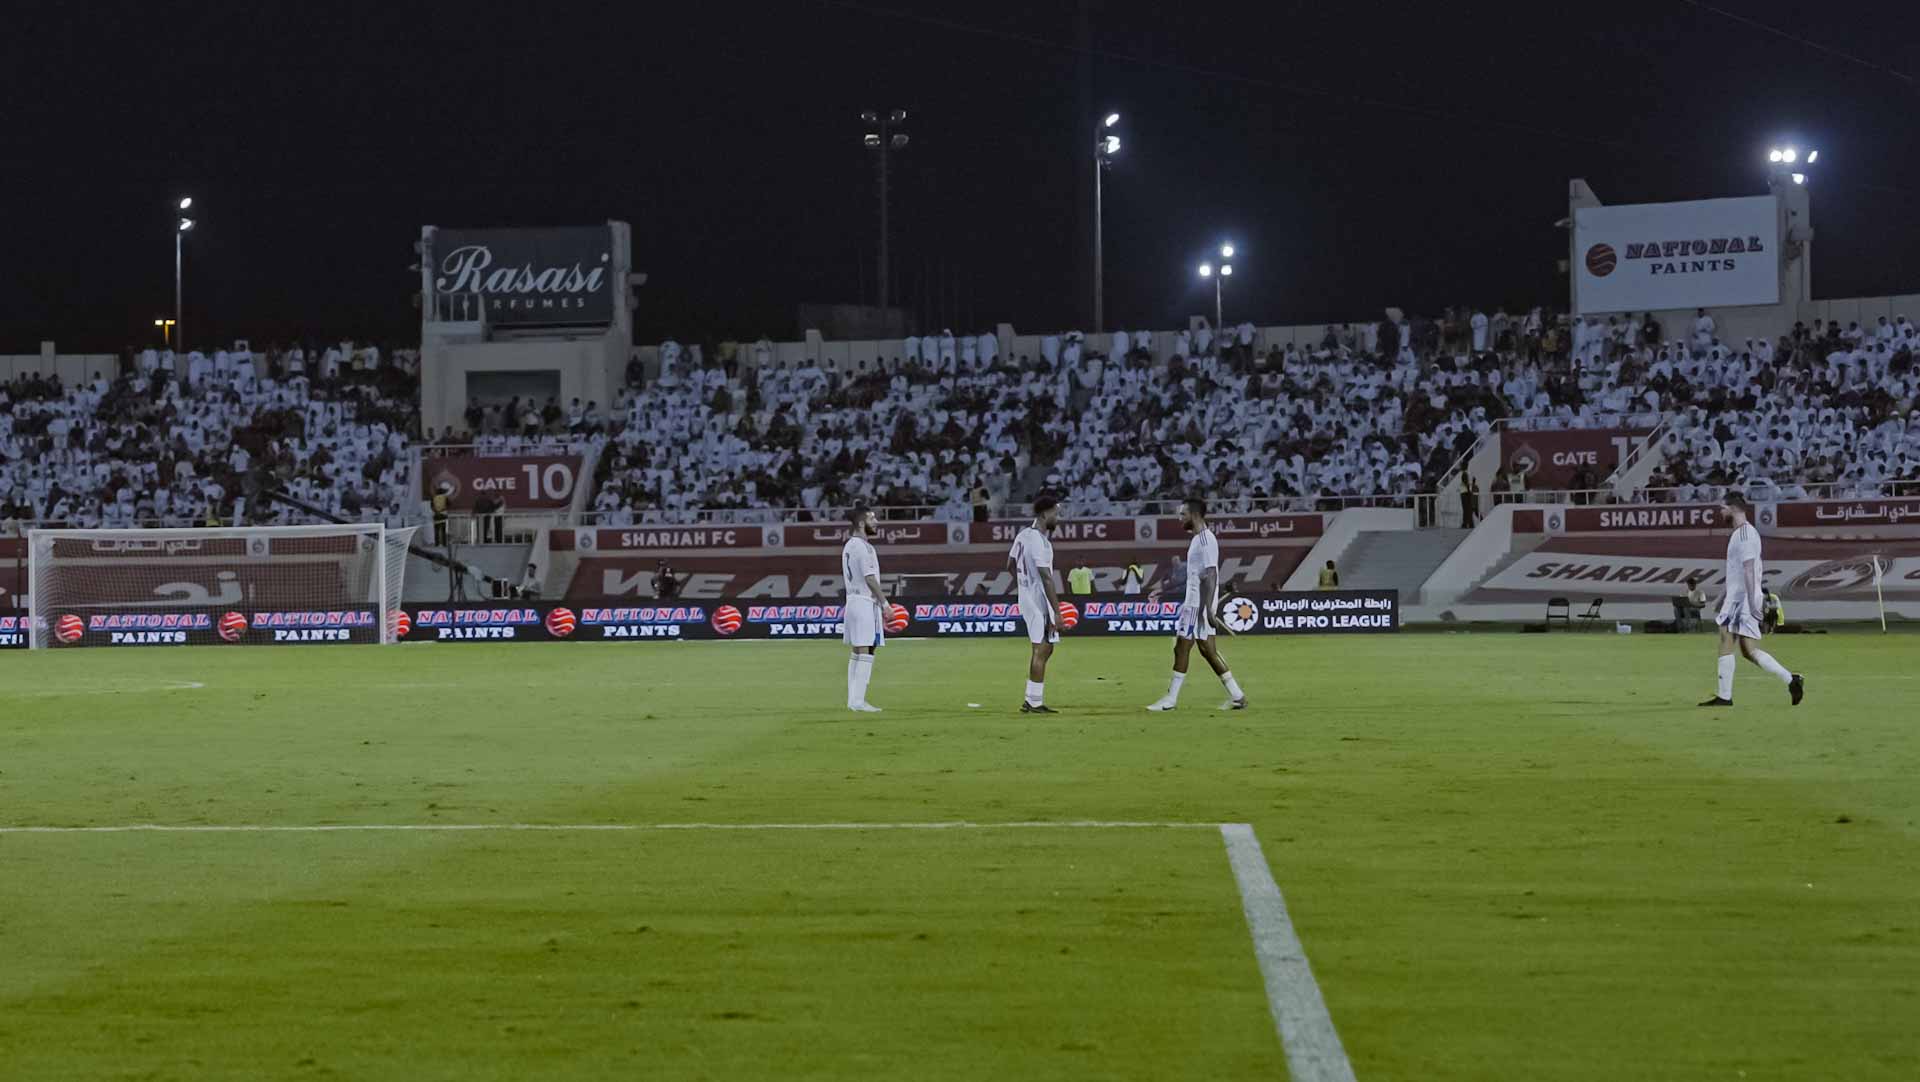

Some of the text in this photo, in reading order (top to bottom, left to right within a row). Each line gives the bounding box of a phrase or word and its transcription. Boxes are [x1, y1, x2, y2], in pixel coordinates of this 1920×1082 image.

[1625, 236, 1764, 260] NATIONAL
[436, 245, 609, 293] Rasasi
[1651, 259, 1736, 275] PAINTS
[1553, 451, 1598, 466] GATE
[472, 463, 573, 500] GATE 10
[1600, 509, 1715, 527] SHARJAH FC
[1083, 524, 1107, 539] FC
[1260, 519, 1294, 537] نادي
[621, 531, 736, 547] SHARJAH FC
[1526, 562, 1720, 585] SHARJAH
[1311, 598, 1362, 610] المحترفين
[1364, 598, 1392, 609] رابطة
[89, 613, 211, 629] NATIONAL
[252, 611, 374, 628] NATIONAL
[416, 608, 538, 624] NATIONAL
[581, 607, 704, 622] NATIONAL
[1263, 614, 1391, 628] UAE PRO LEAGUE
[438, 626, 515, 639] PAINTS
[603, 625, 680, 637] PAINTS
[938, 621, 1016, 633] PAINTS
[111, 631, 187, 643] PAINTS
[274, 629, 350, 641] PAINTS
